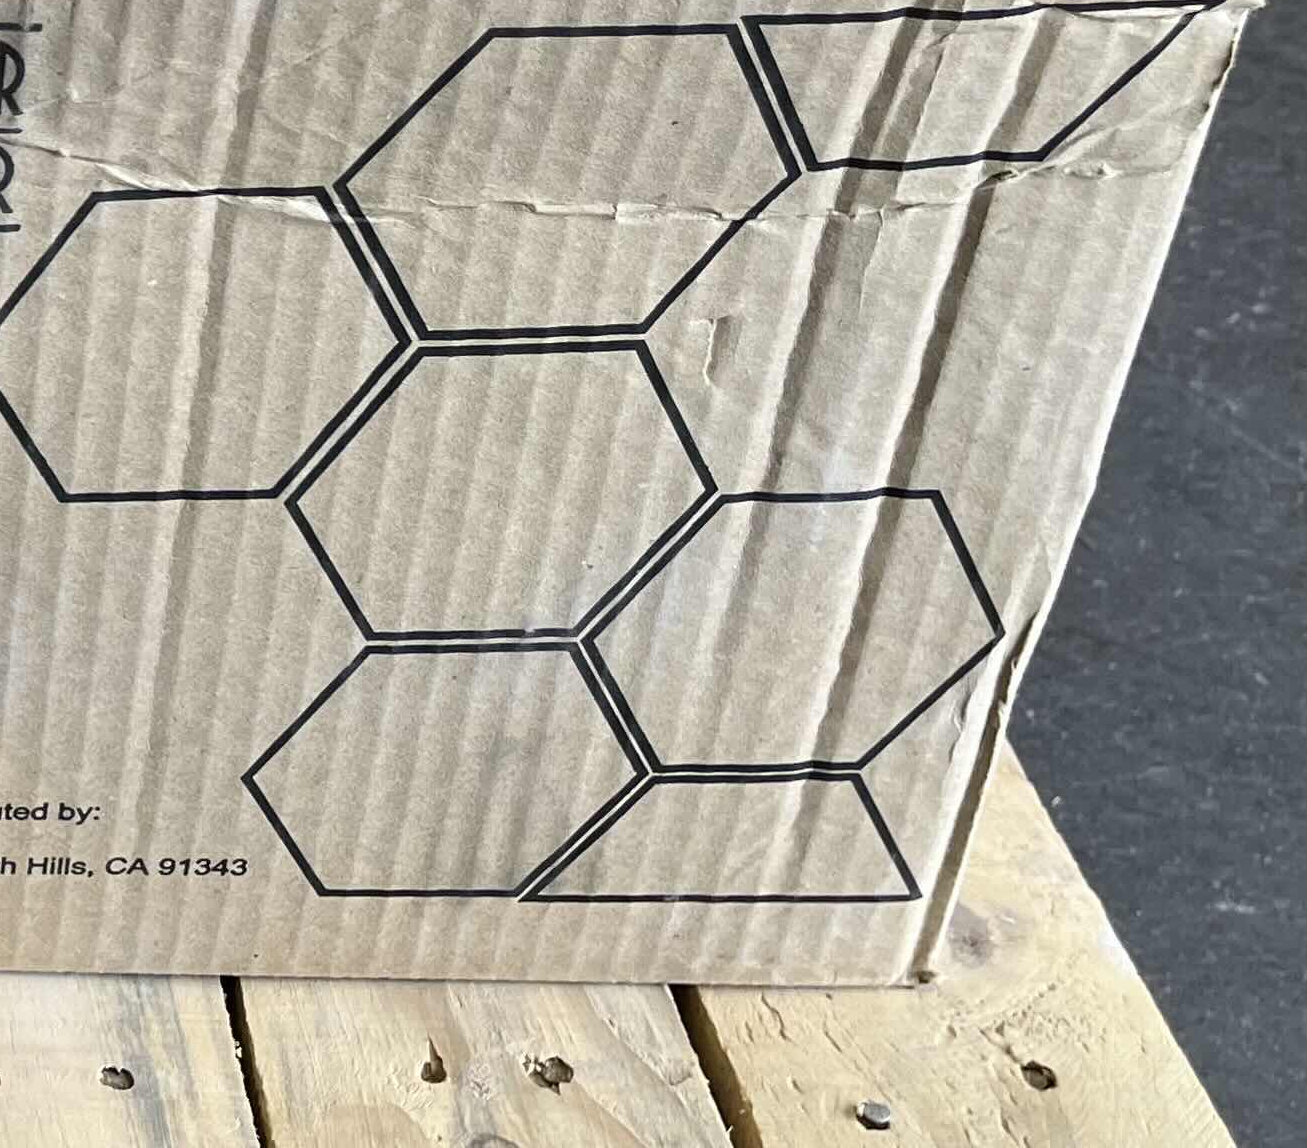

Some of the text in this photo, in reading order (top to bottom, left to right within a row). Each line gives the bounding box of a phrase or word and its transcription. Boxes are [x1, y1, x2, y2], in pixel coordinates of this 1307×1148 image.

[58, 802, 101, 825] by:
[27, 857, 94, 878] Hills,
[105, 858, 149, 876] CA
[158, 858, 248, 876] 91343
